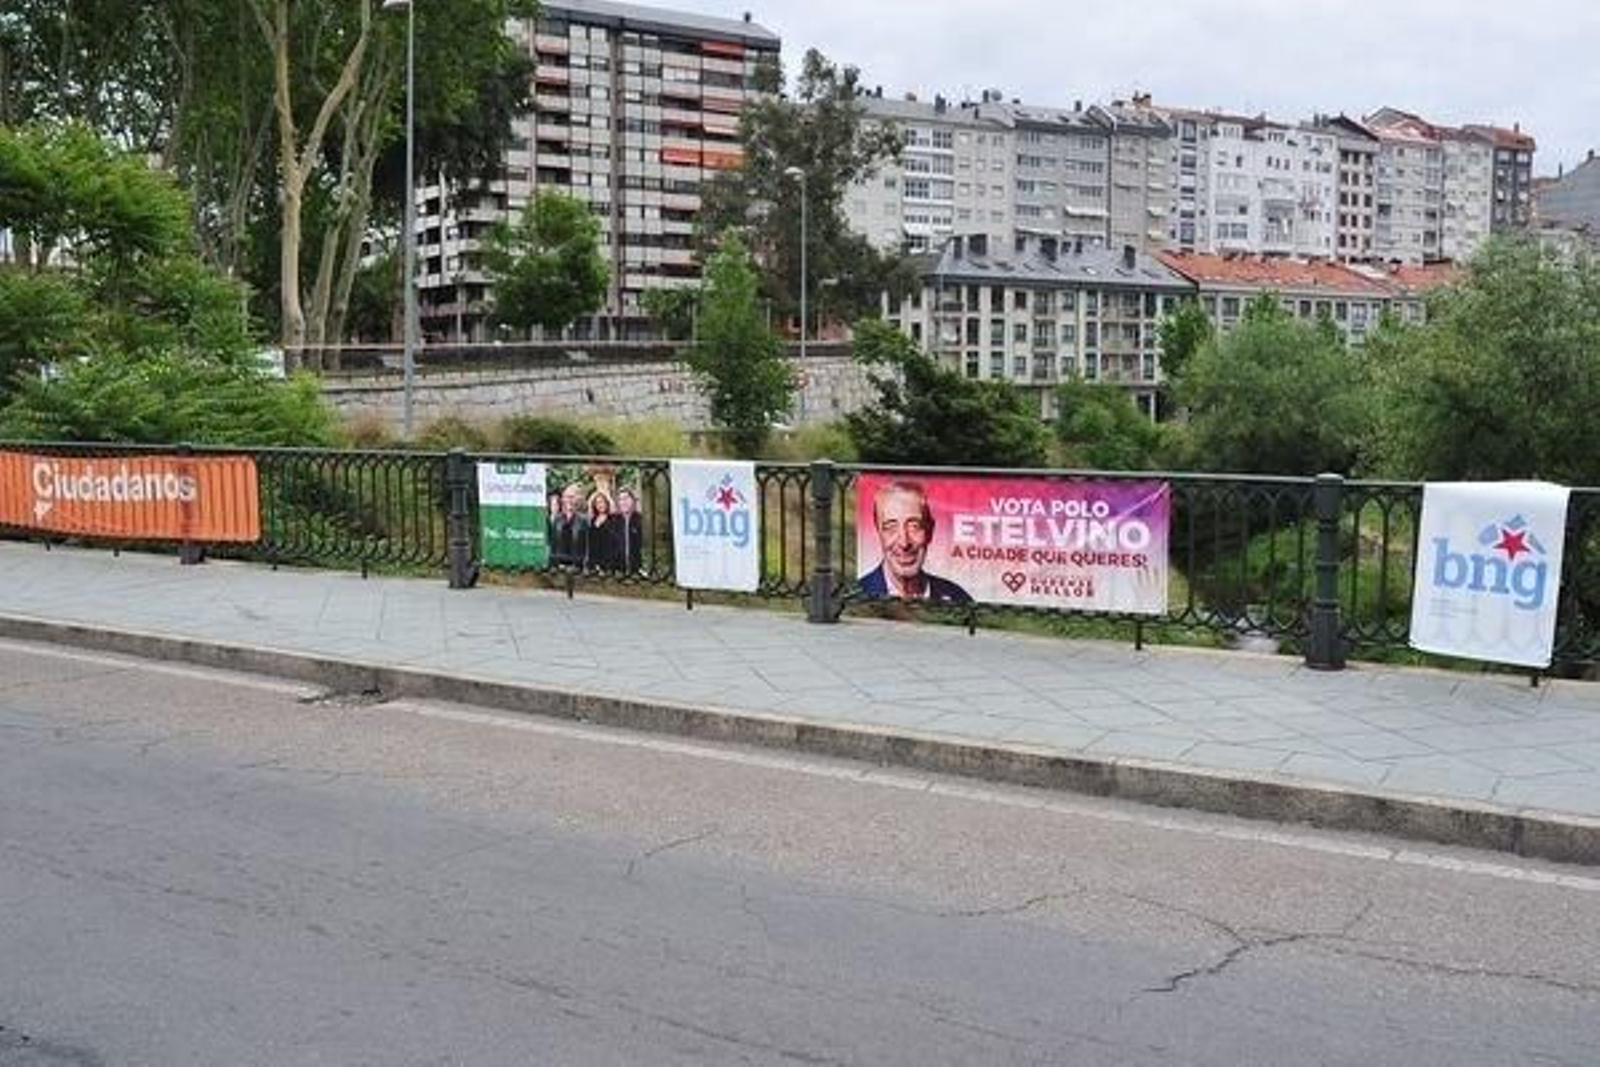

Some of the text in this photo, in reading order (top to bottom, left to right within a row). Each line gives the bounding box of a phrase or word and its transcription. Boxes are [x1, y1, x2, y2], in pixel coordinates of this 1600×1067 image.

[33, 463, 197, 502] Ciudadanos
[681, 497, 750, 547] bng
[991, 497, 1110, 518] VOTA POLO
[952, 514, 1150, 551] ETELVINO
[951, 545, 1147, 569] A CIDADE QUE QUERES!
[1432, 537, 1548, 611] bng
